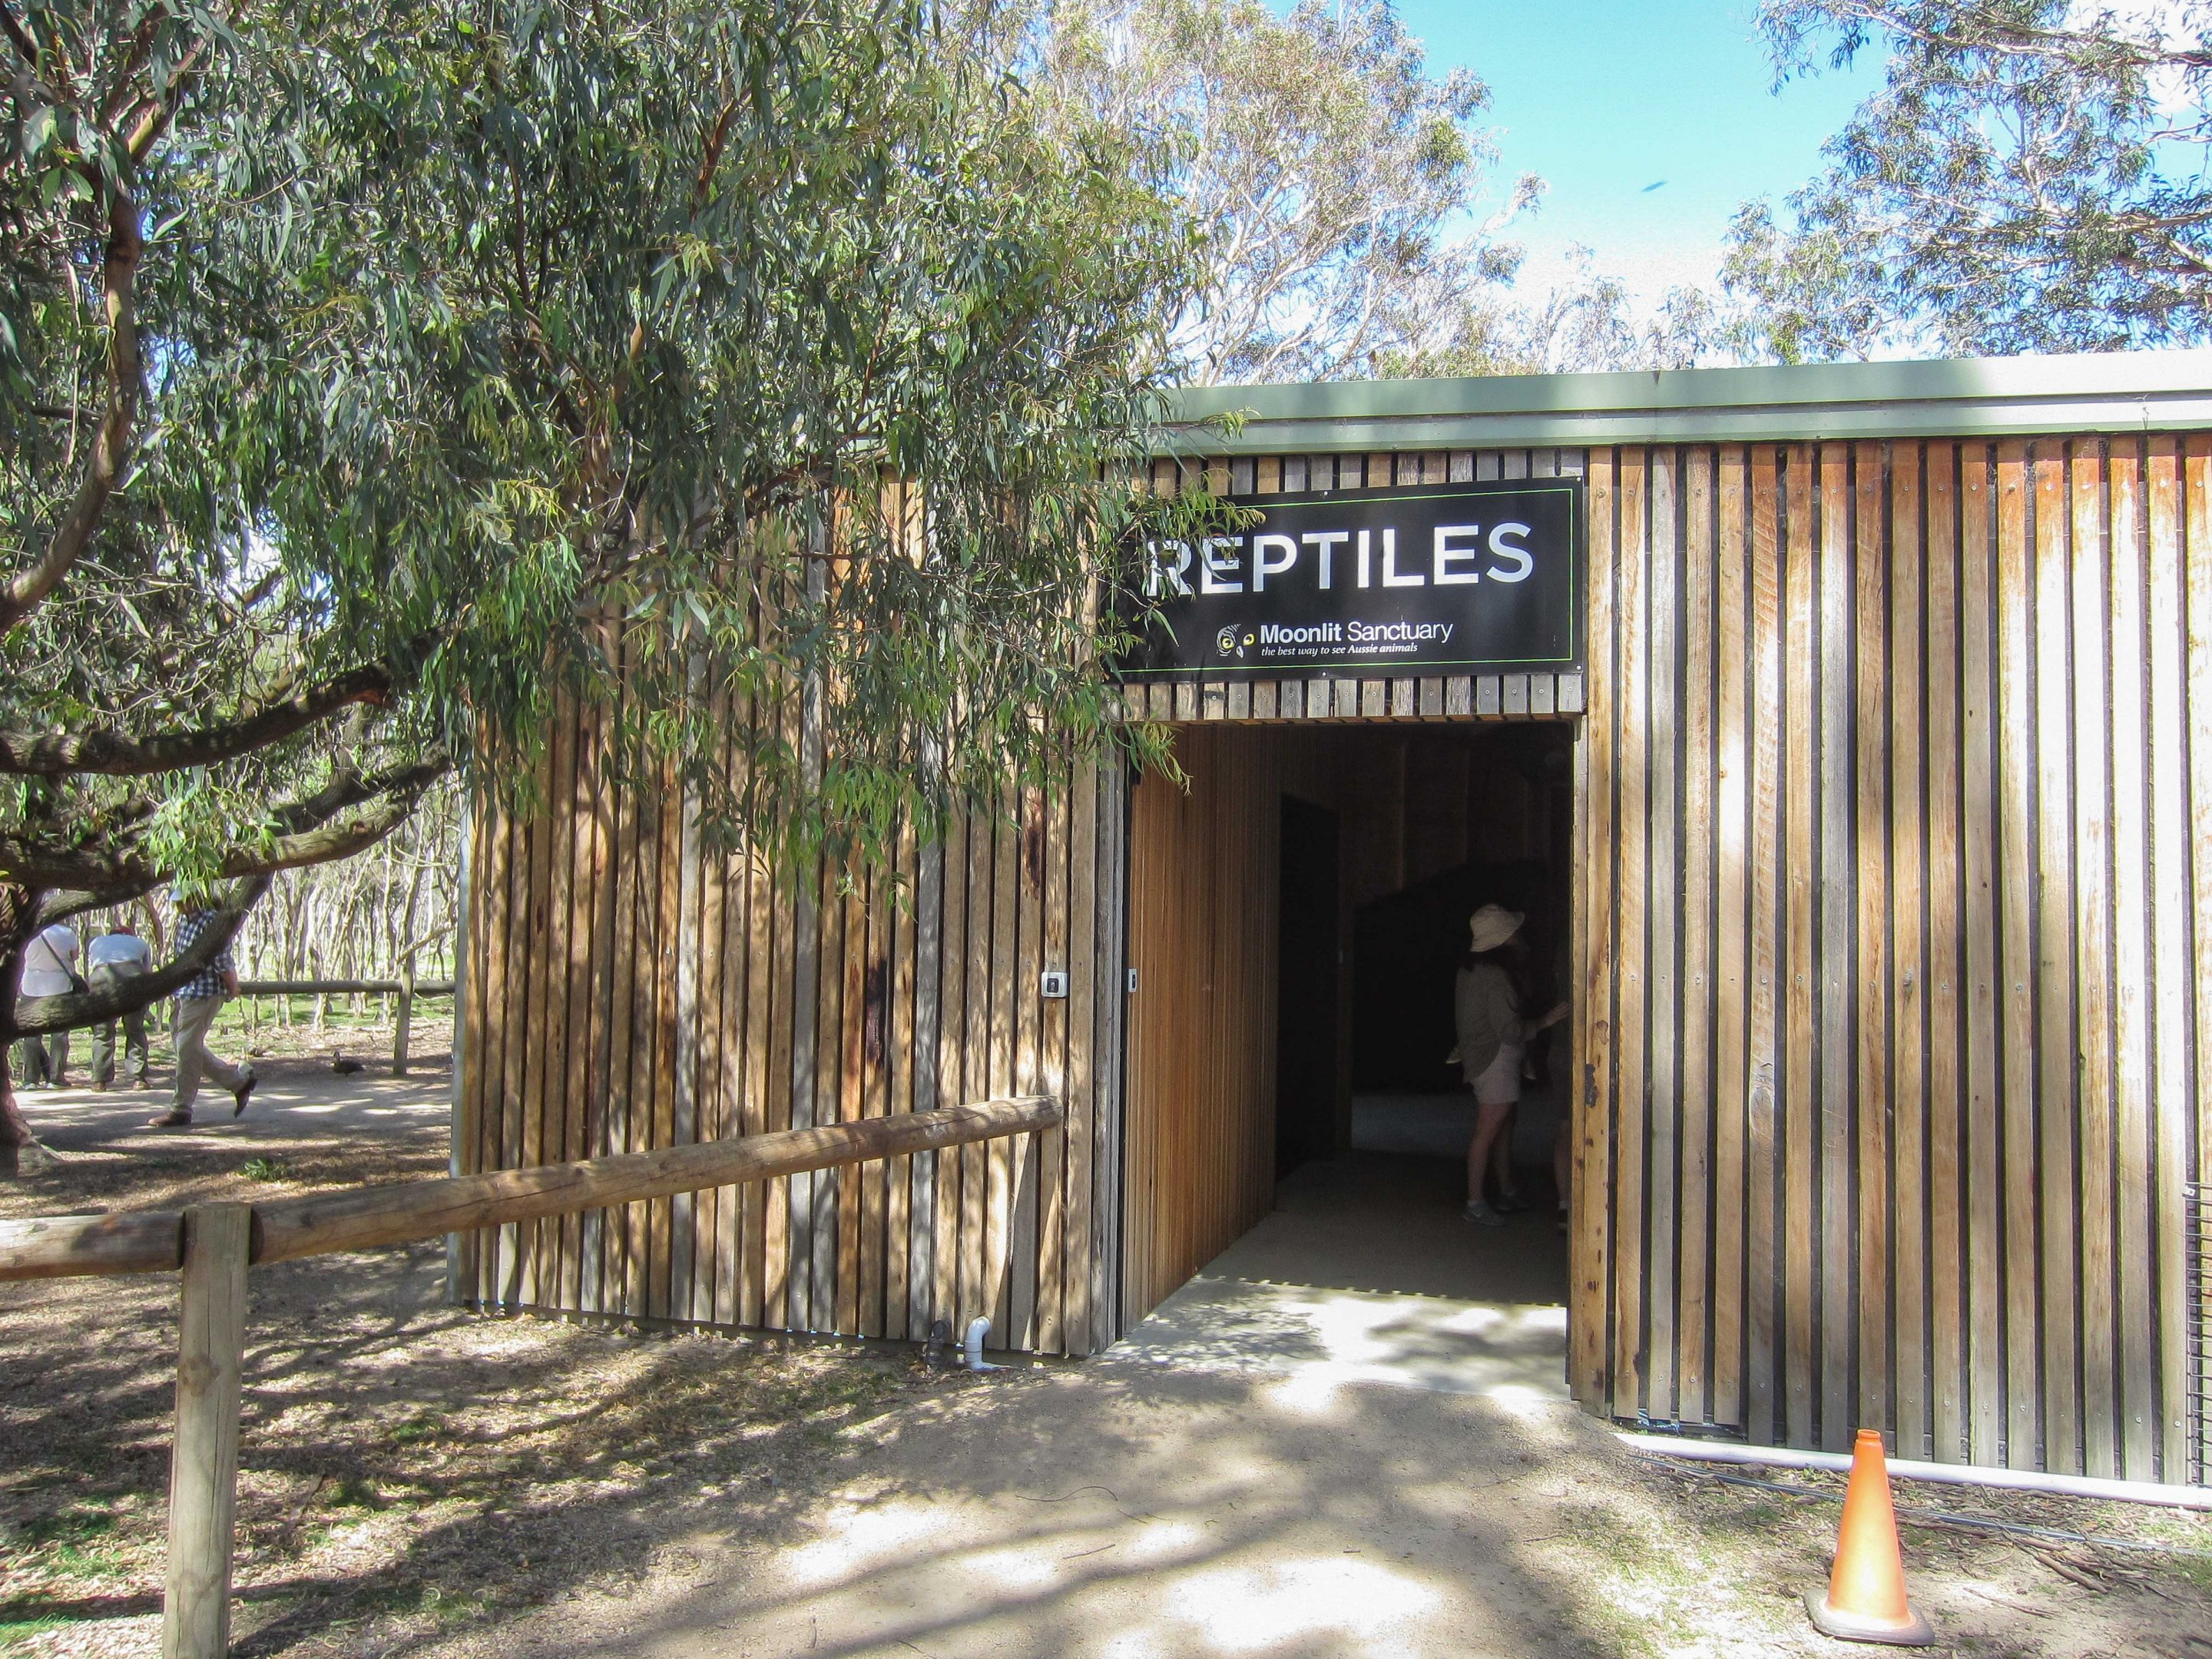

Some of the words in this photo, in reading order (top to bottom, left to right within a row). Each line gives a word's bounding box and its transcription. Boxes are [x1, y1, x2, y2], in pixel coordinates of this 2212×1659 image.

[1147, 522, 1535, 597] REPTILES
[1260, 623, 1343, 644] Moonlit
[1347, 620, 1453, 643] Sanctuary
[1261, 647, 1276, 656] the
[1278, 646, 1296, 656] best
[1298, 647, 1318, 657] way
[1320, 646, 1330, 654] to
[1348, 643, 1379, 654] Aussie
[1379, 643, 1418, 653] animals
